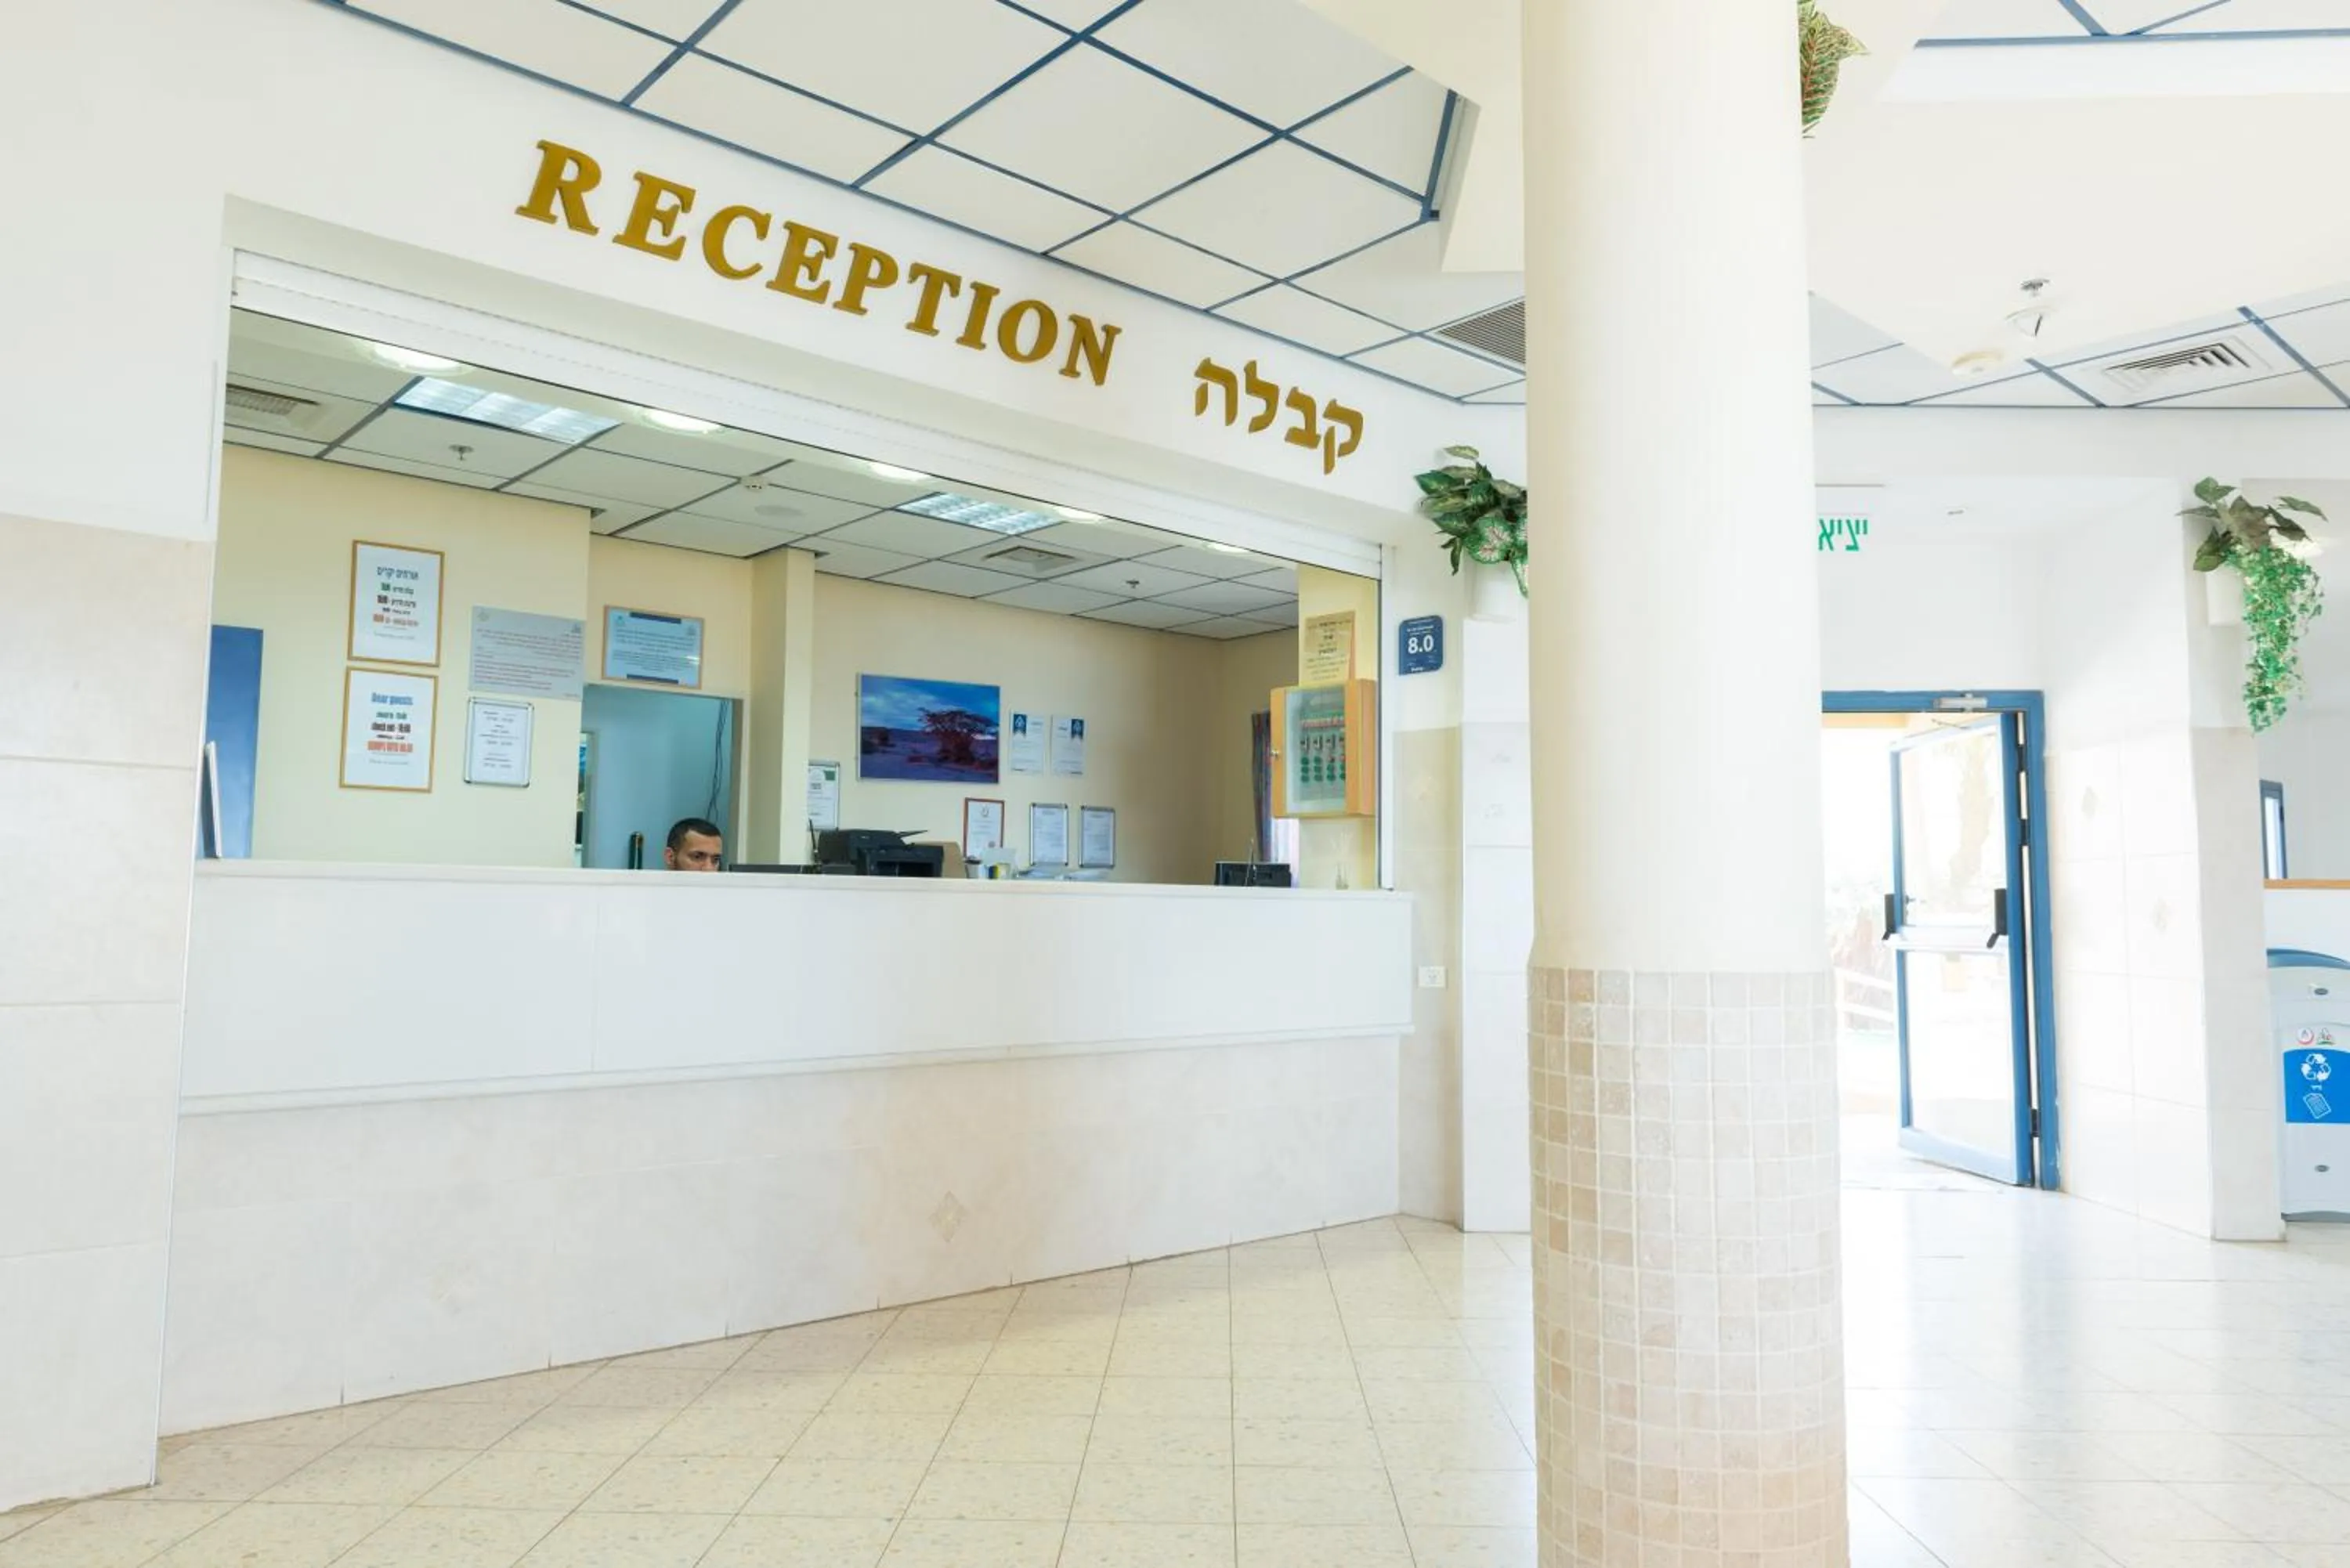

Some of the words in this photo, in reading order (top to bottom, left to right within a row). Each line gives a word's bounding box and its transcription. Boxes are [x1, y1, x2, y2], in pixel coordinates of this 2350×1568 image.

[517, 139, 1122, 387] RECEPTION
[1194, 358, 1364, 474] קבלה
[1817, 518, 1868, 551] יציא
[1408, 634, 1434, 654] 8.0
